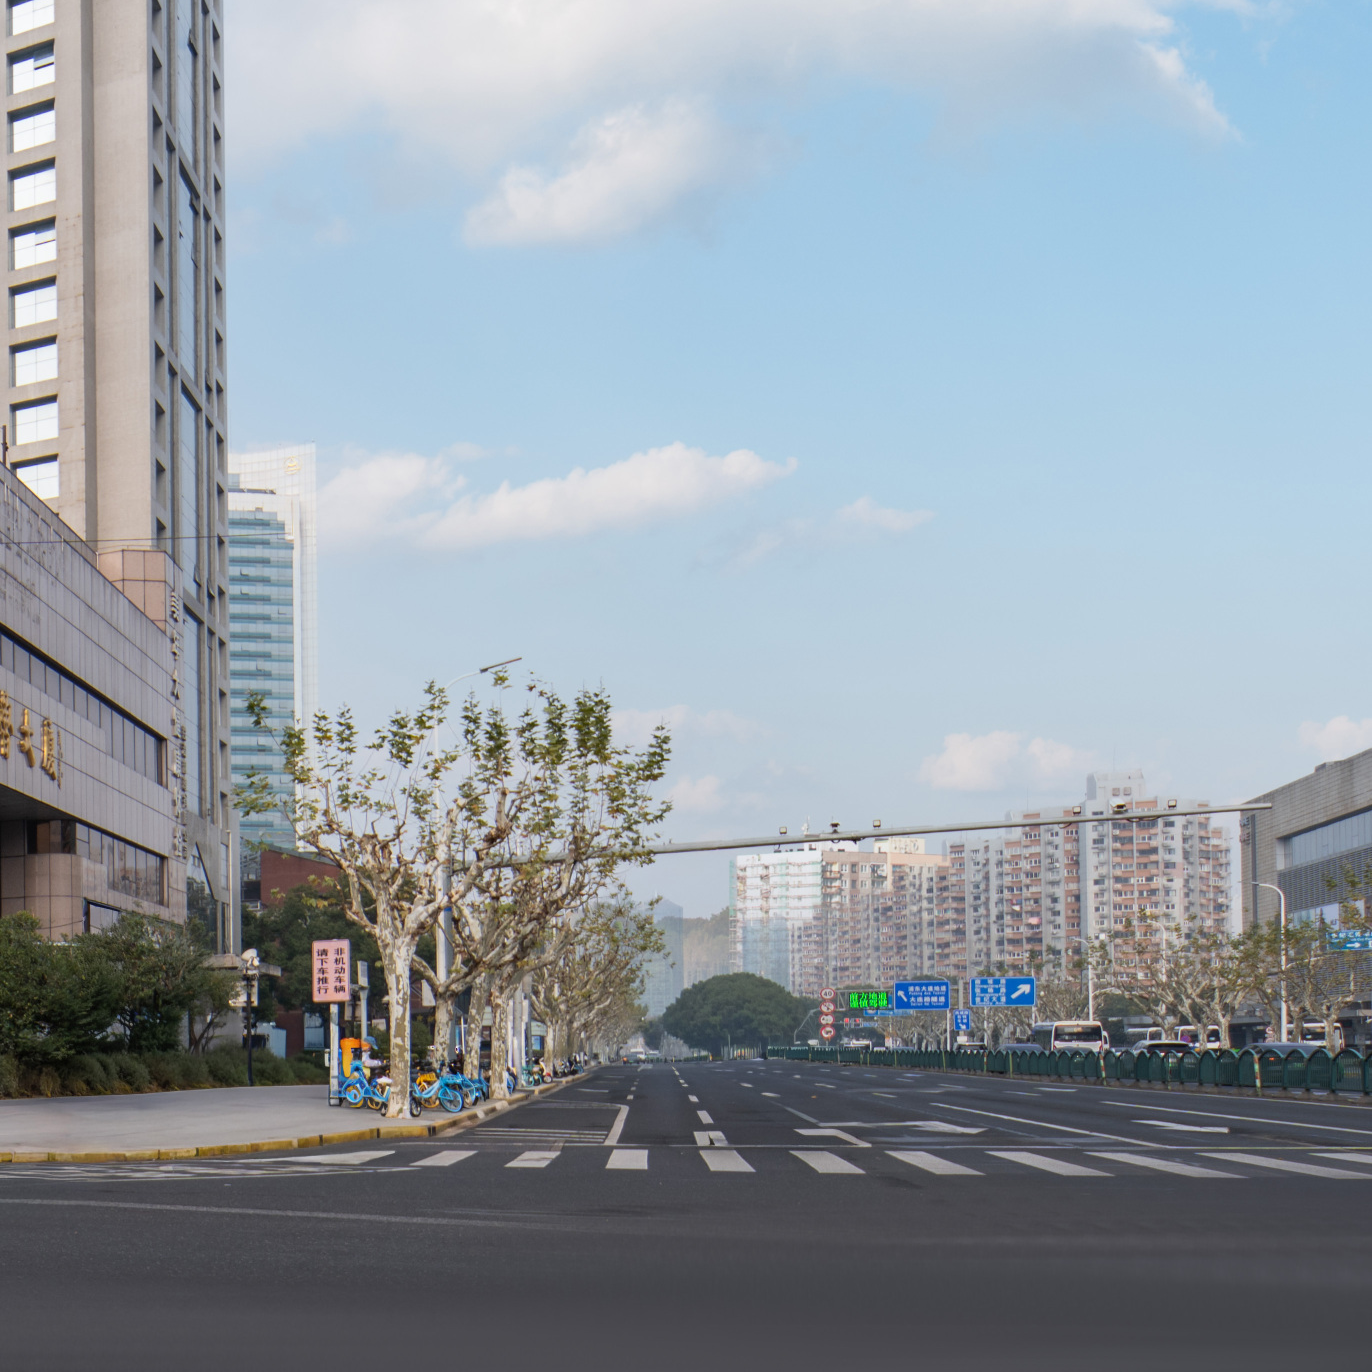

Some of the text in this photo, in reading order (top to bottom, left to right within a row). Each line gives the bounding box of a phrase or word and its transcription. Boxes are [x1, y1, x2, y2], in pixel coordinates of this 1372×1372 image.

[316, 948, 329, 995] 请下车推行
[333, 947, 347, 994] 非机动车辆
